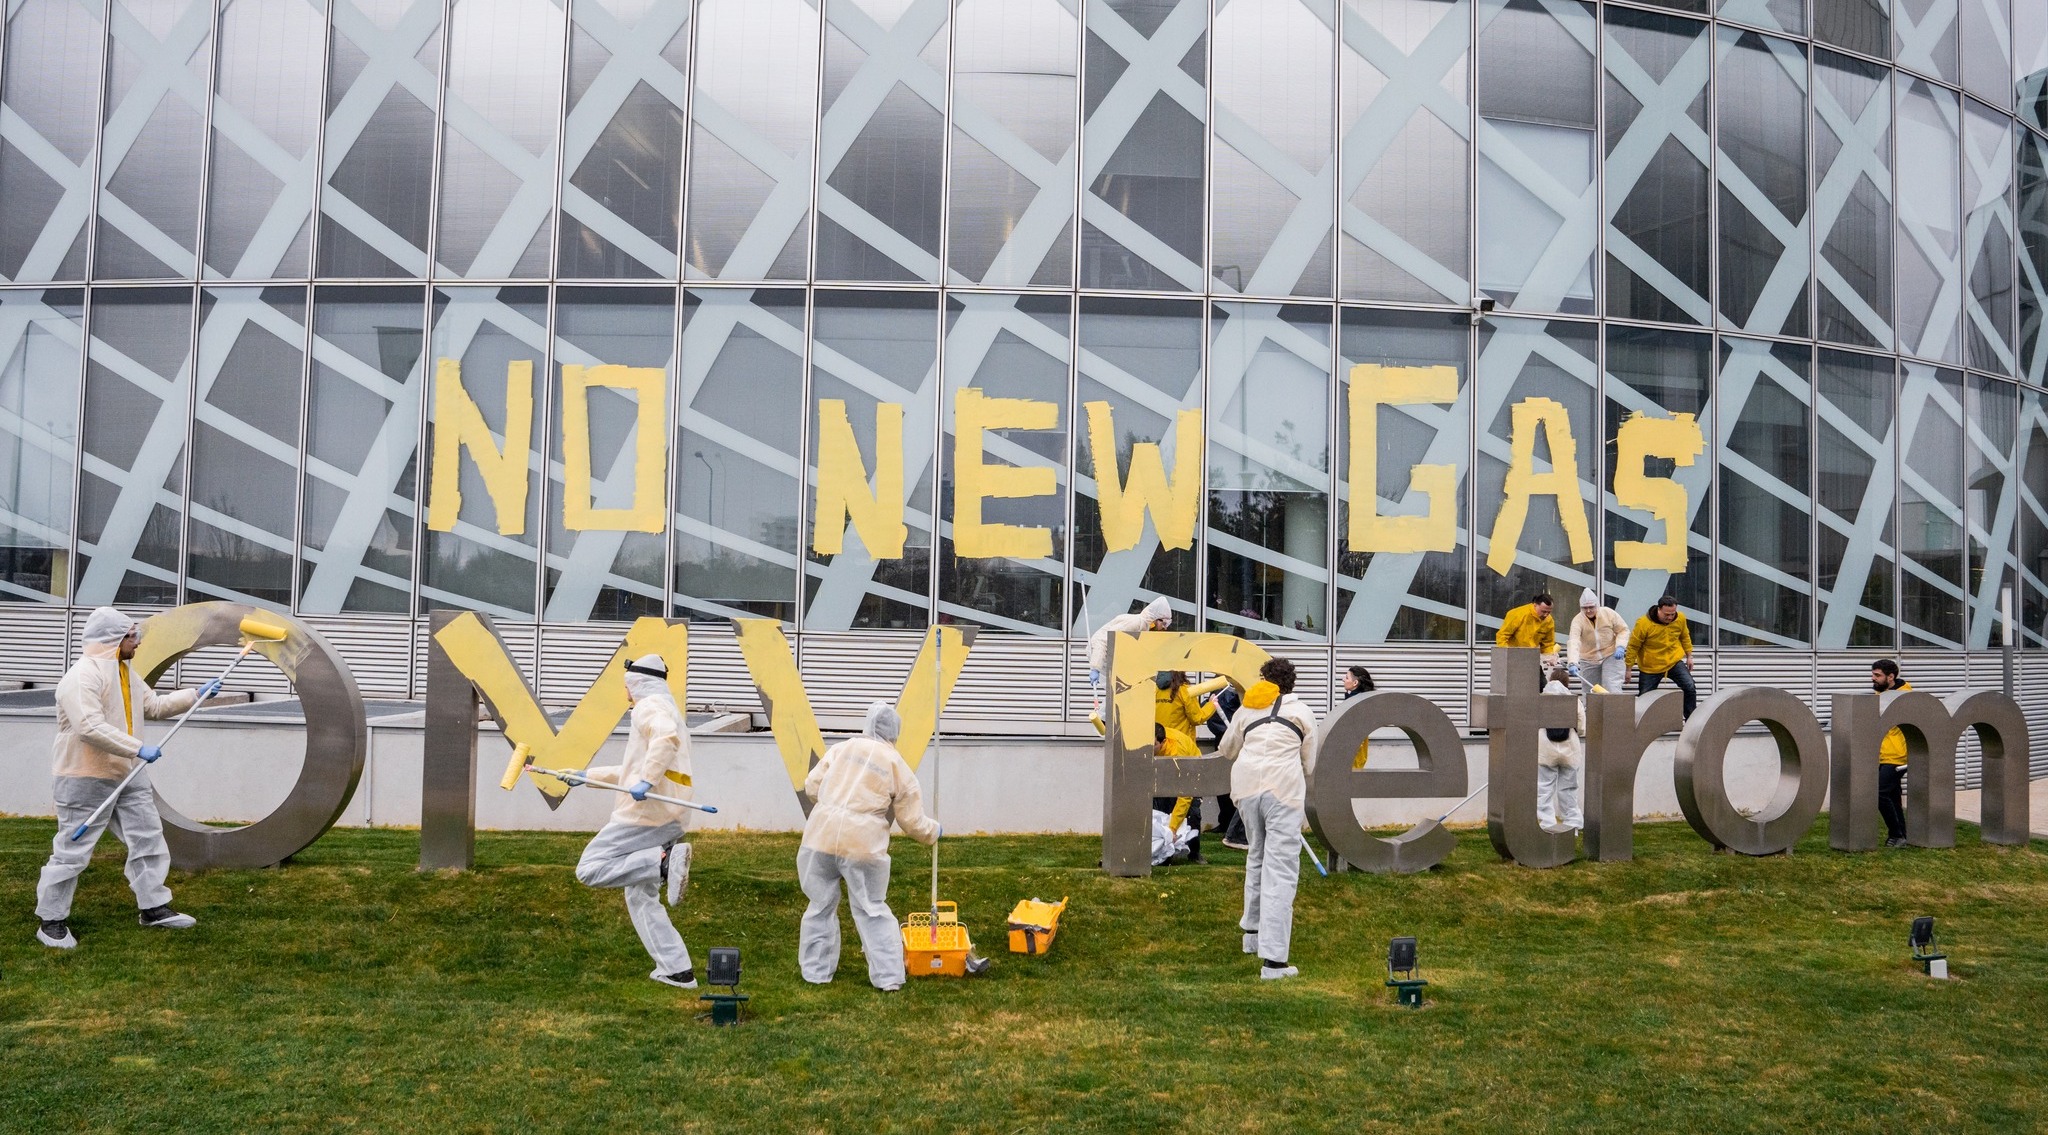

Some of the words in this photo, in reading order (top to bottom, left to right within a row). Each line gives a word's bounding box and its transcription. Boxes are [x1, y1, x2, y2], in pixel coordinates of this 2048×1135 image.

[428, 359, 666, 535] NO
[813, 388, 1203, 560] NEW
[1347, 364, 1706, 576] GAS
[129, 601, 978, 872] OMV
[1103, 631, 2030, 876] Petrom
